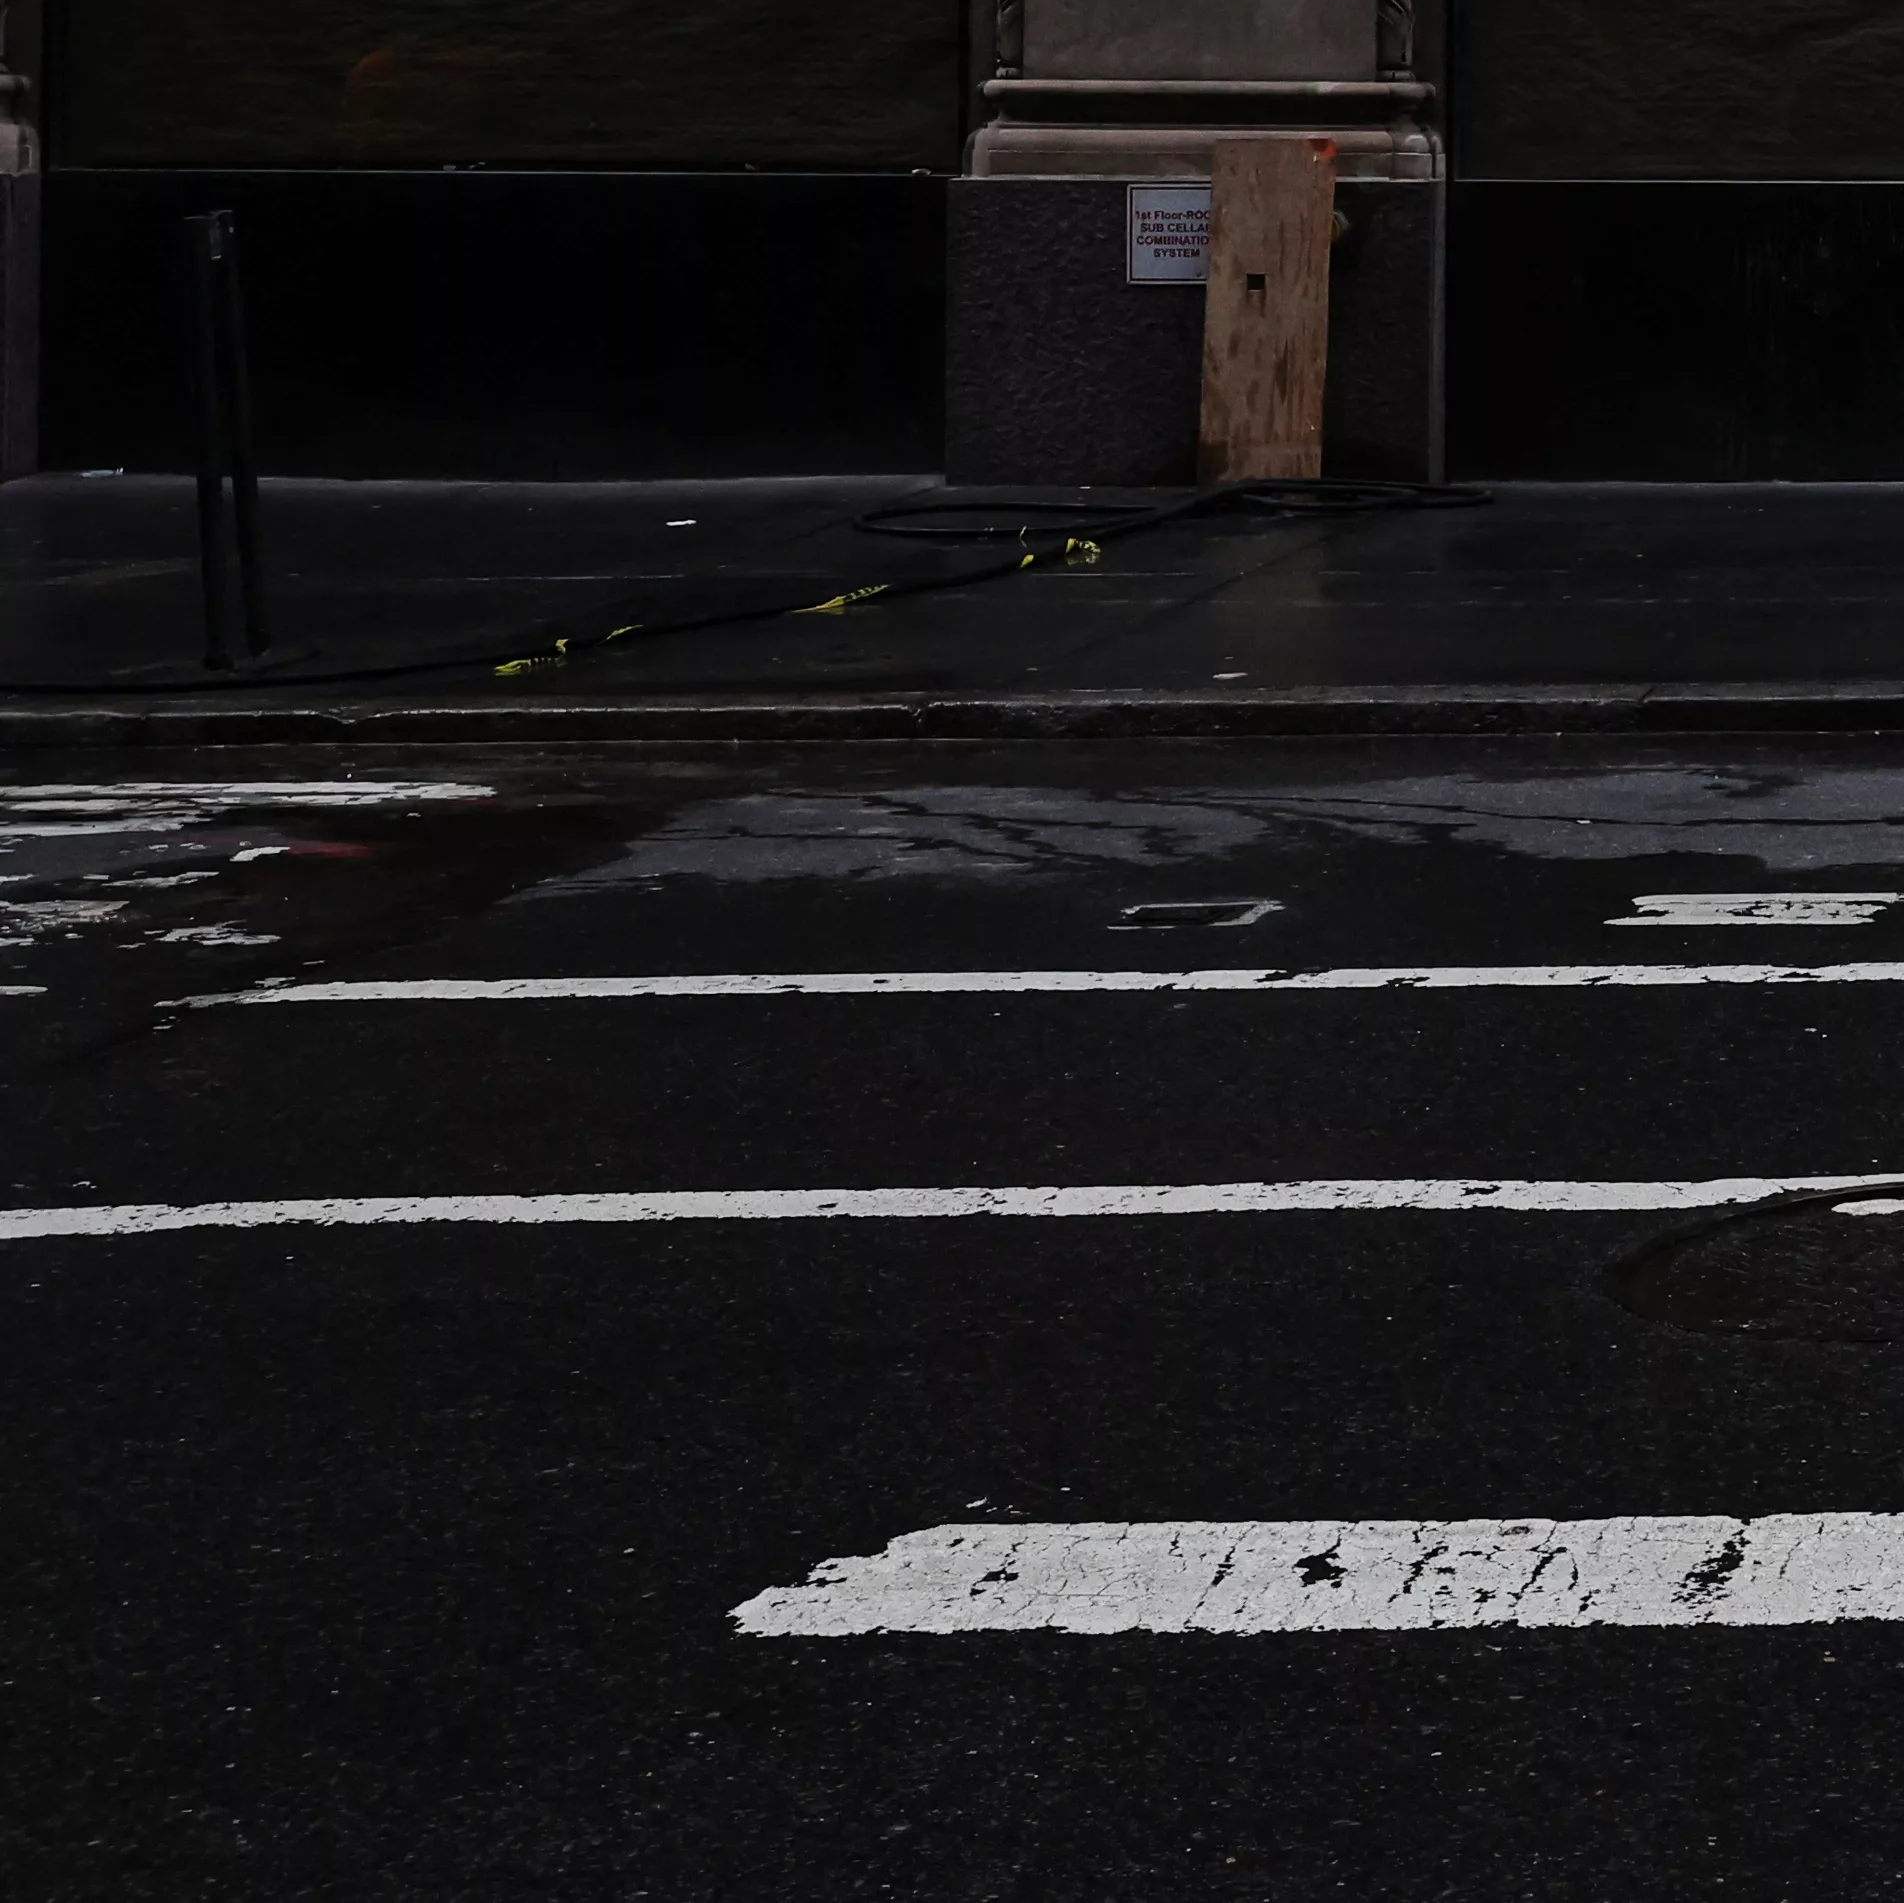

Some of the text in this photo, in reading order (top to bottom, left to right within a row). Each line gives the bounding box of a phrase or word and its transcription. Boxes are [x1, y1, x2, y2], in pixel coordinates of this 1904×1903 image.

[1154, 210, 1210, 220] Floor-ROO
[1140, 223, 1164, 232] SUB
[1136, 235, 1209, 245] COMBINATIO
[1153, 248, 1200, 258] SYSTEM
